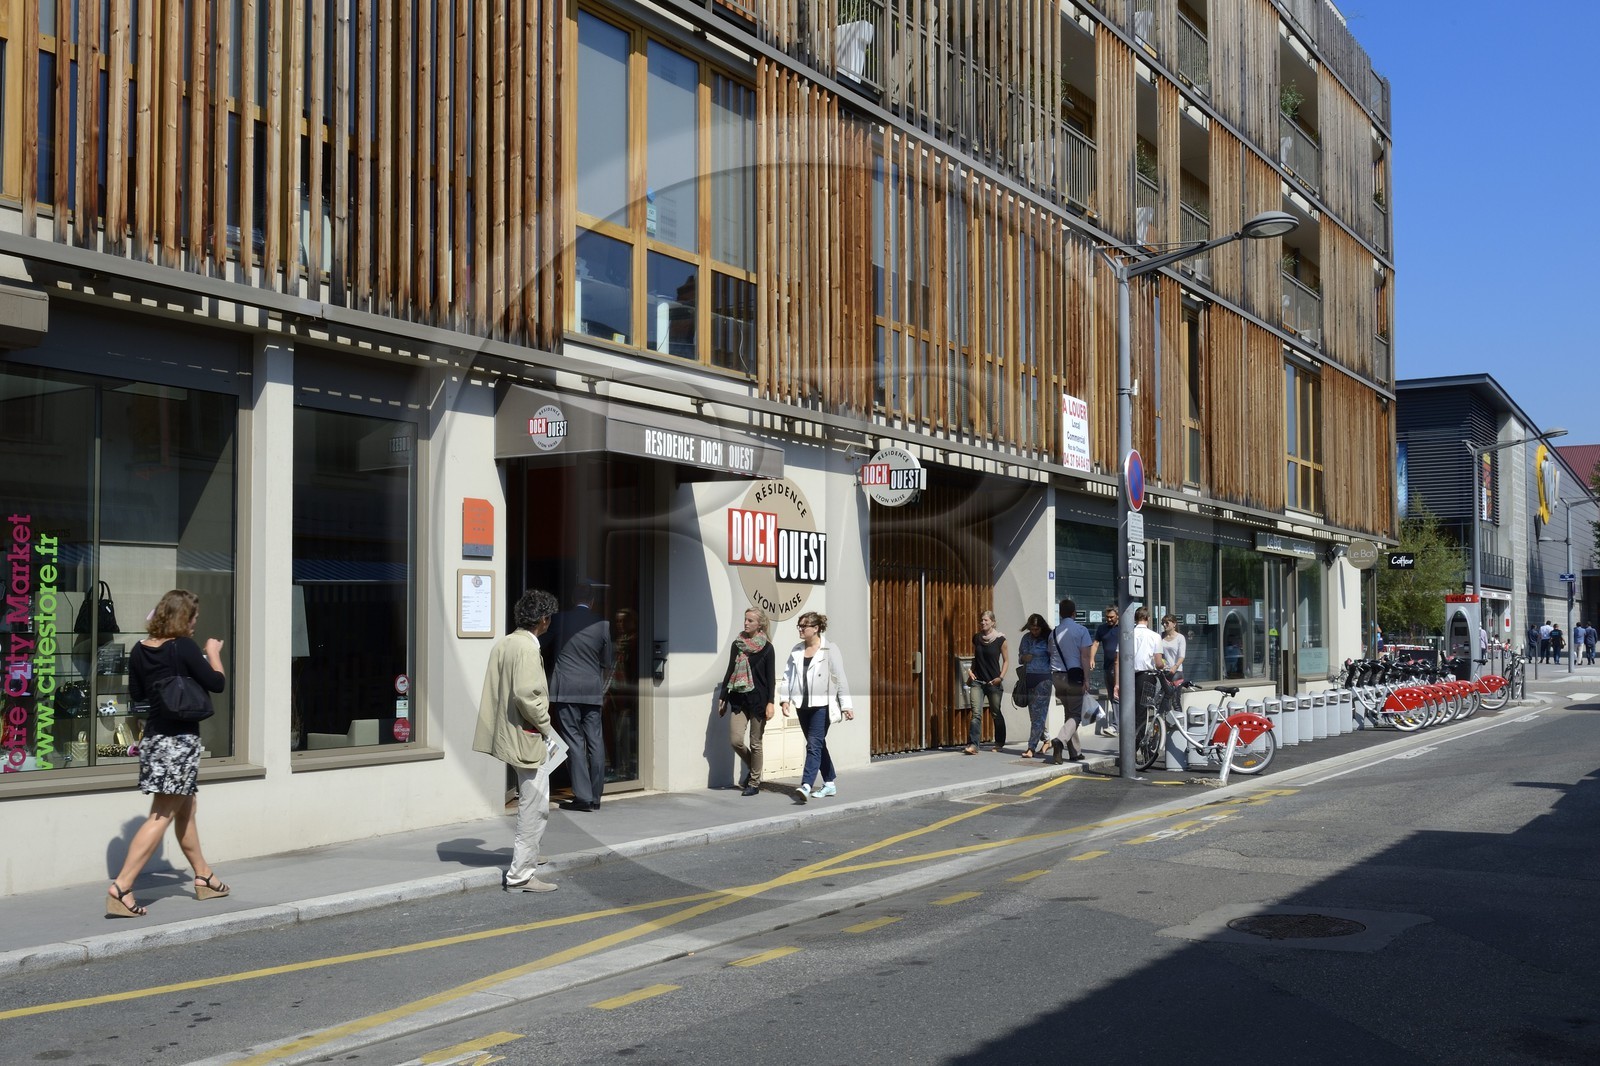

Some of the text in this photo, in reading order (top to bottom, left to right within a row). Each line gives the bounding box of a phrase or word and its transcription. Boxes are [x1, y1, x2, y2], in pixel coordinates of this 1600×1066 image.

[1062, 398, 1087, 421] A LOUER
[529, 418, 546, 434] DOCK
[547, 421, 568, 437] OUEST
[1071, 419, 1081, 430] Local
[1066, 431, 1086, 445] Commercial
[645, 429, 754, 471] RESIDENCE DOCK OUEST
[1063, 452, 1069, 466] 04
[1070, 453, 1075, 467] 37
[863, 465, 888, 484] DOCK
[890, 470, 920, 490] OUEST
[755, 483, 807, 518] RÉSIDENCE
[875, 494, 889, 503] LYON
[891, 494, 906, 503] VAISE
[732, 510, 776, 563] DOCK
[778, 529, 827, 581] OUEST
[1349, 549, 1375, 558] Le Bot
[6, 513, 31, 624] Market
[753, 589, 802, 614] LYON VAISE
[4, 633, 34, 697] City
